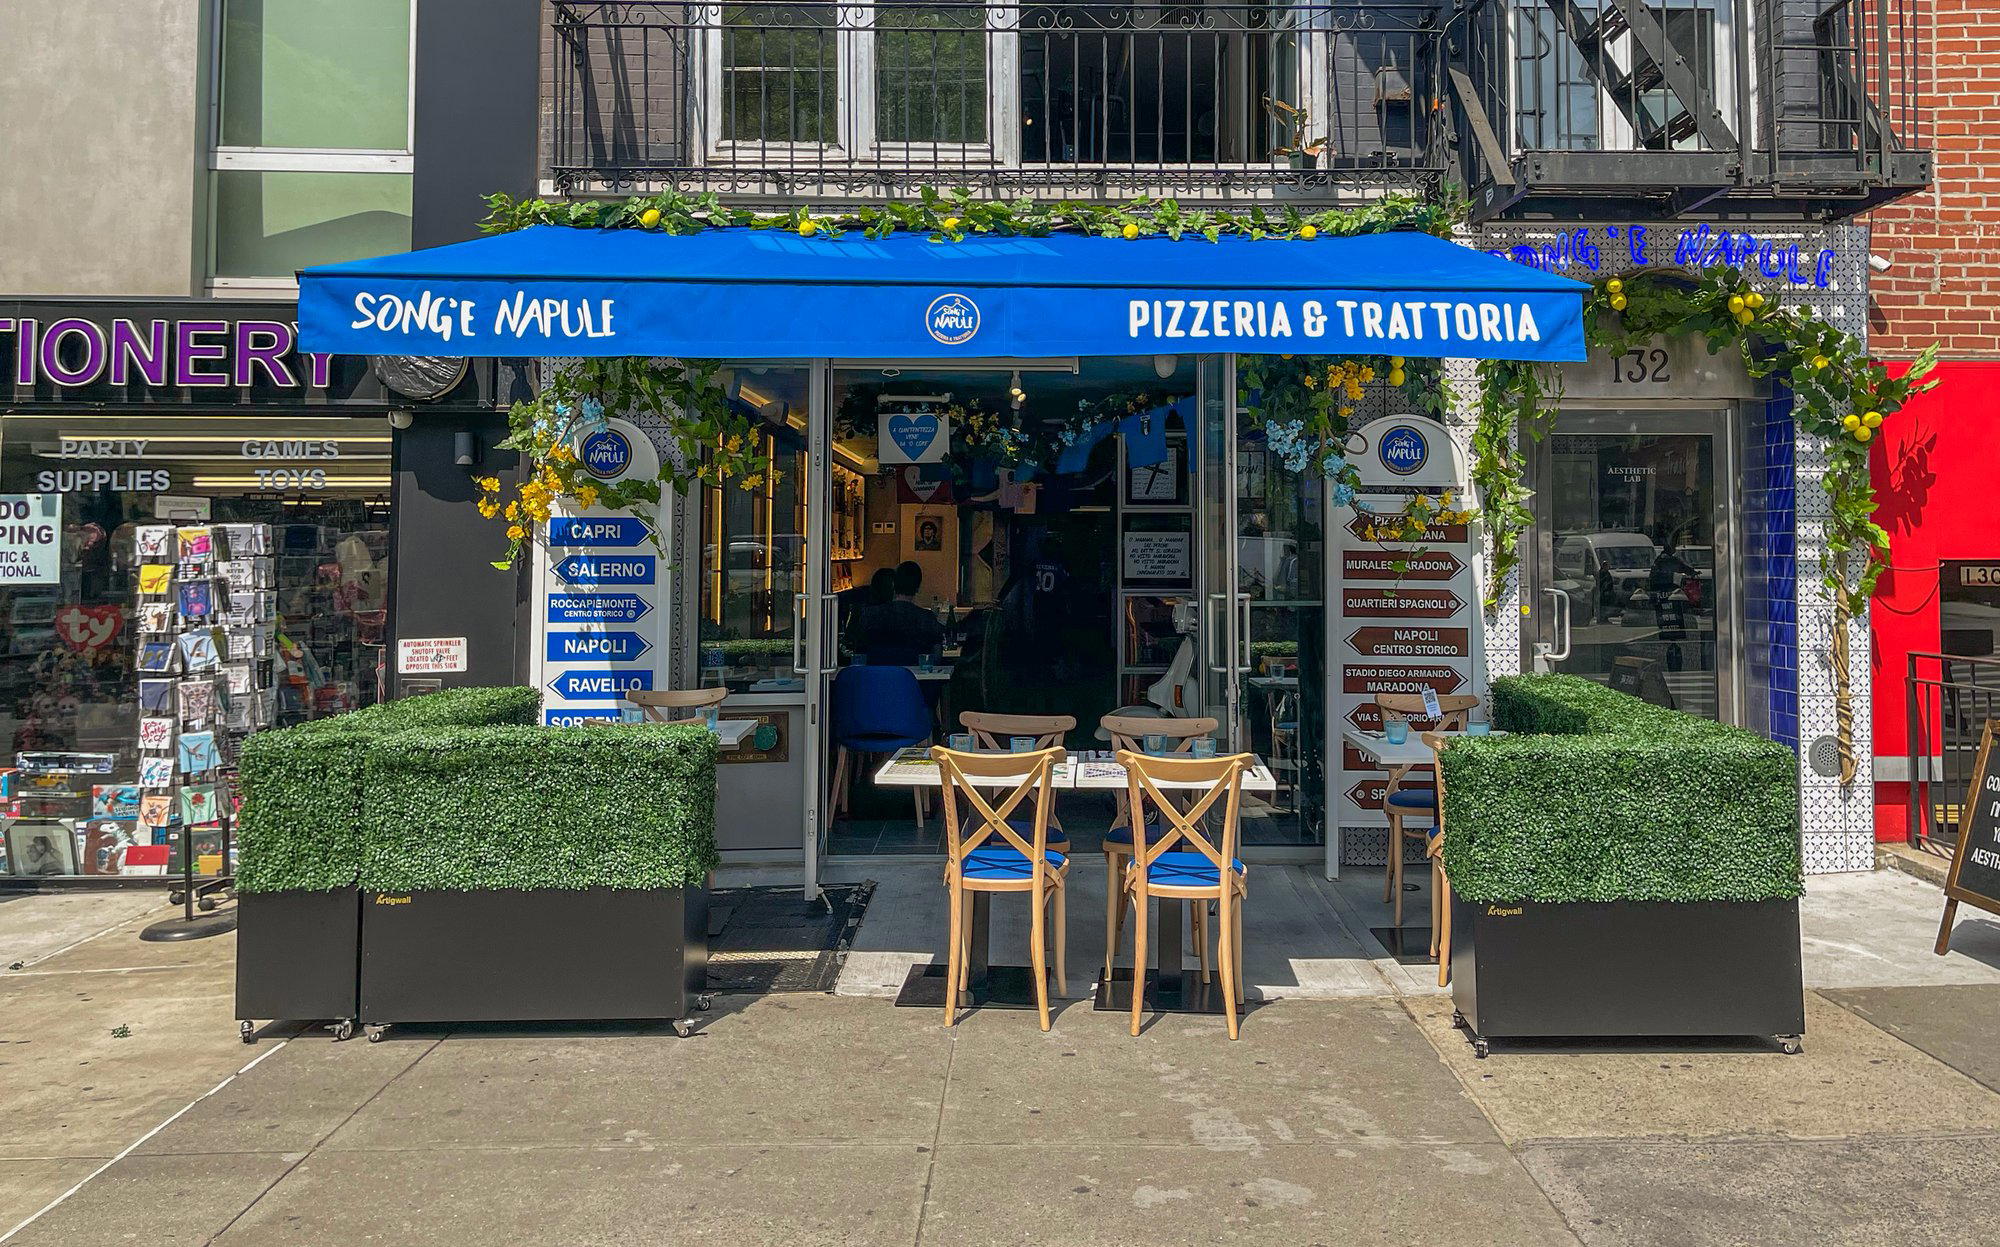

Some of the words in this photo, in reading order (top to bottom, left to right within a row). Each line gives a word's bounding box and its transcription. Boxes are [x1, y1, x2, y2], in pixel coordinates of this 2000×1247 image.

[1675, 223, 1835, 288] NAPULE
[494, 290, 616, 338] NAPULE
[934, 313, 974, 329] NAPULE
[1129, 300, 1293, 338] PIZZERIA
[1302, 300, 1328, 338] &
[1336, 300, 1541, 342] TRATTORIA
[0, 317, 335, 388] IONER
[1611, 349, 1671, 383] 132
[61, 439, 150, 459] PARTY
[241, 439, 340, 460] GAMES
[1387, 446, 1421, 460] NAPULE
[589, 450, 624, 463] NAPULE
[1608, 467, 1657, 475] AESTHETIC
[37, 469, 172, 492] SUPPLIES
[254, 469, 327, 490] TOYS
[571, 524, 621, 539] CAPRI
[21, 551, 30, 563] &
[568, 562, 646, 578] SALERNO
[1346, 560, 1393, 570] MURALES
[1396, 560, 1454, 571] ARADONA
[1035, 570, 1055, 592] 10
[550, 599, 637, 609] ROCCAPIEMONTE
[1346, 598, 1397, 608] QUARTIERI
[1399, 599, 1447, 609] SPAGNOLI
[564, 610, 592, 618] CENTRO
[593, 610, 624, 618] STORICO
[61, 608, 115, 646] ty
[1394, 630, 1439, 641] NAPOLI
[564, 639, 627, 653] NAPOLI
[1373, 644, 1413, 654] CENTRO
[1415, 645, 1458, 655] STORICO
[1345, 669, 1377, 677] STADIO
[1378, 669, 1406, 677] DIEGO
[1407, 669, 1451, 678] ARMANDO
[569, 678, 642, 692] RAVELLO
[1367, 682, 1430, 692] MARADONA
[1357, 713, 1371, 721] VIA
